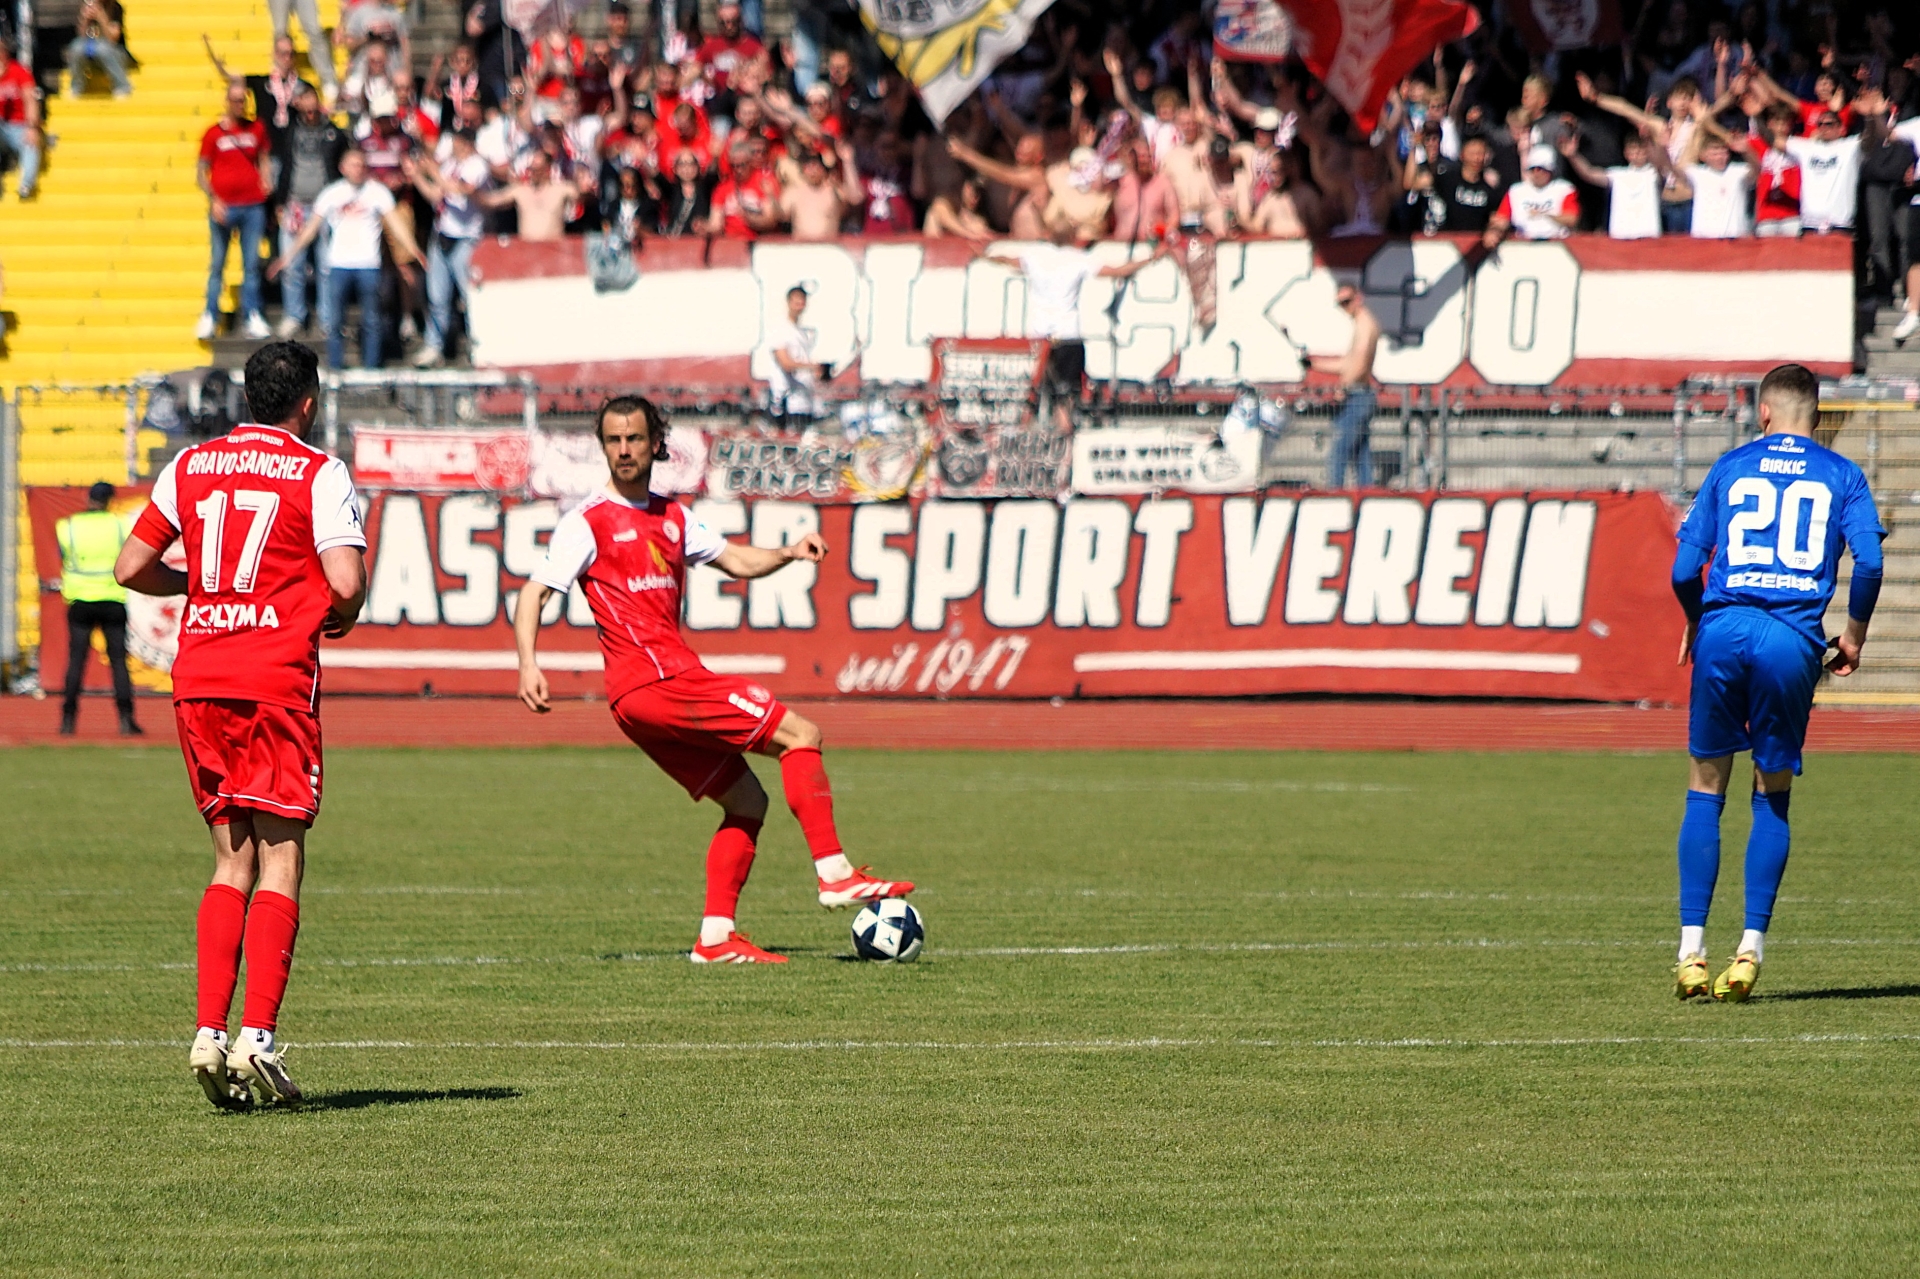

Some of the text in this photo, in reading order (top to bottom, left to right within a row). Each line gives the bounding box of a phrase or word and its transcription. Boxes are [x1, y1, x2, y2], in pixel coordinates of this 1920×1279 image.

[1760, 458, 1806, 474] BIRKIC
[195, 489, 281, 594] 17
[356, 496, 1598, 632] ASSER SPORT VEREIN
[1726, 476, 1833, 572] 20
[835, 642, 910, 694] seit
